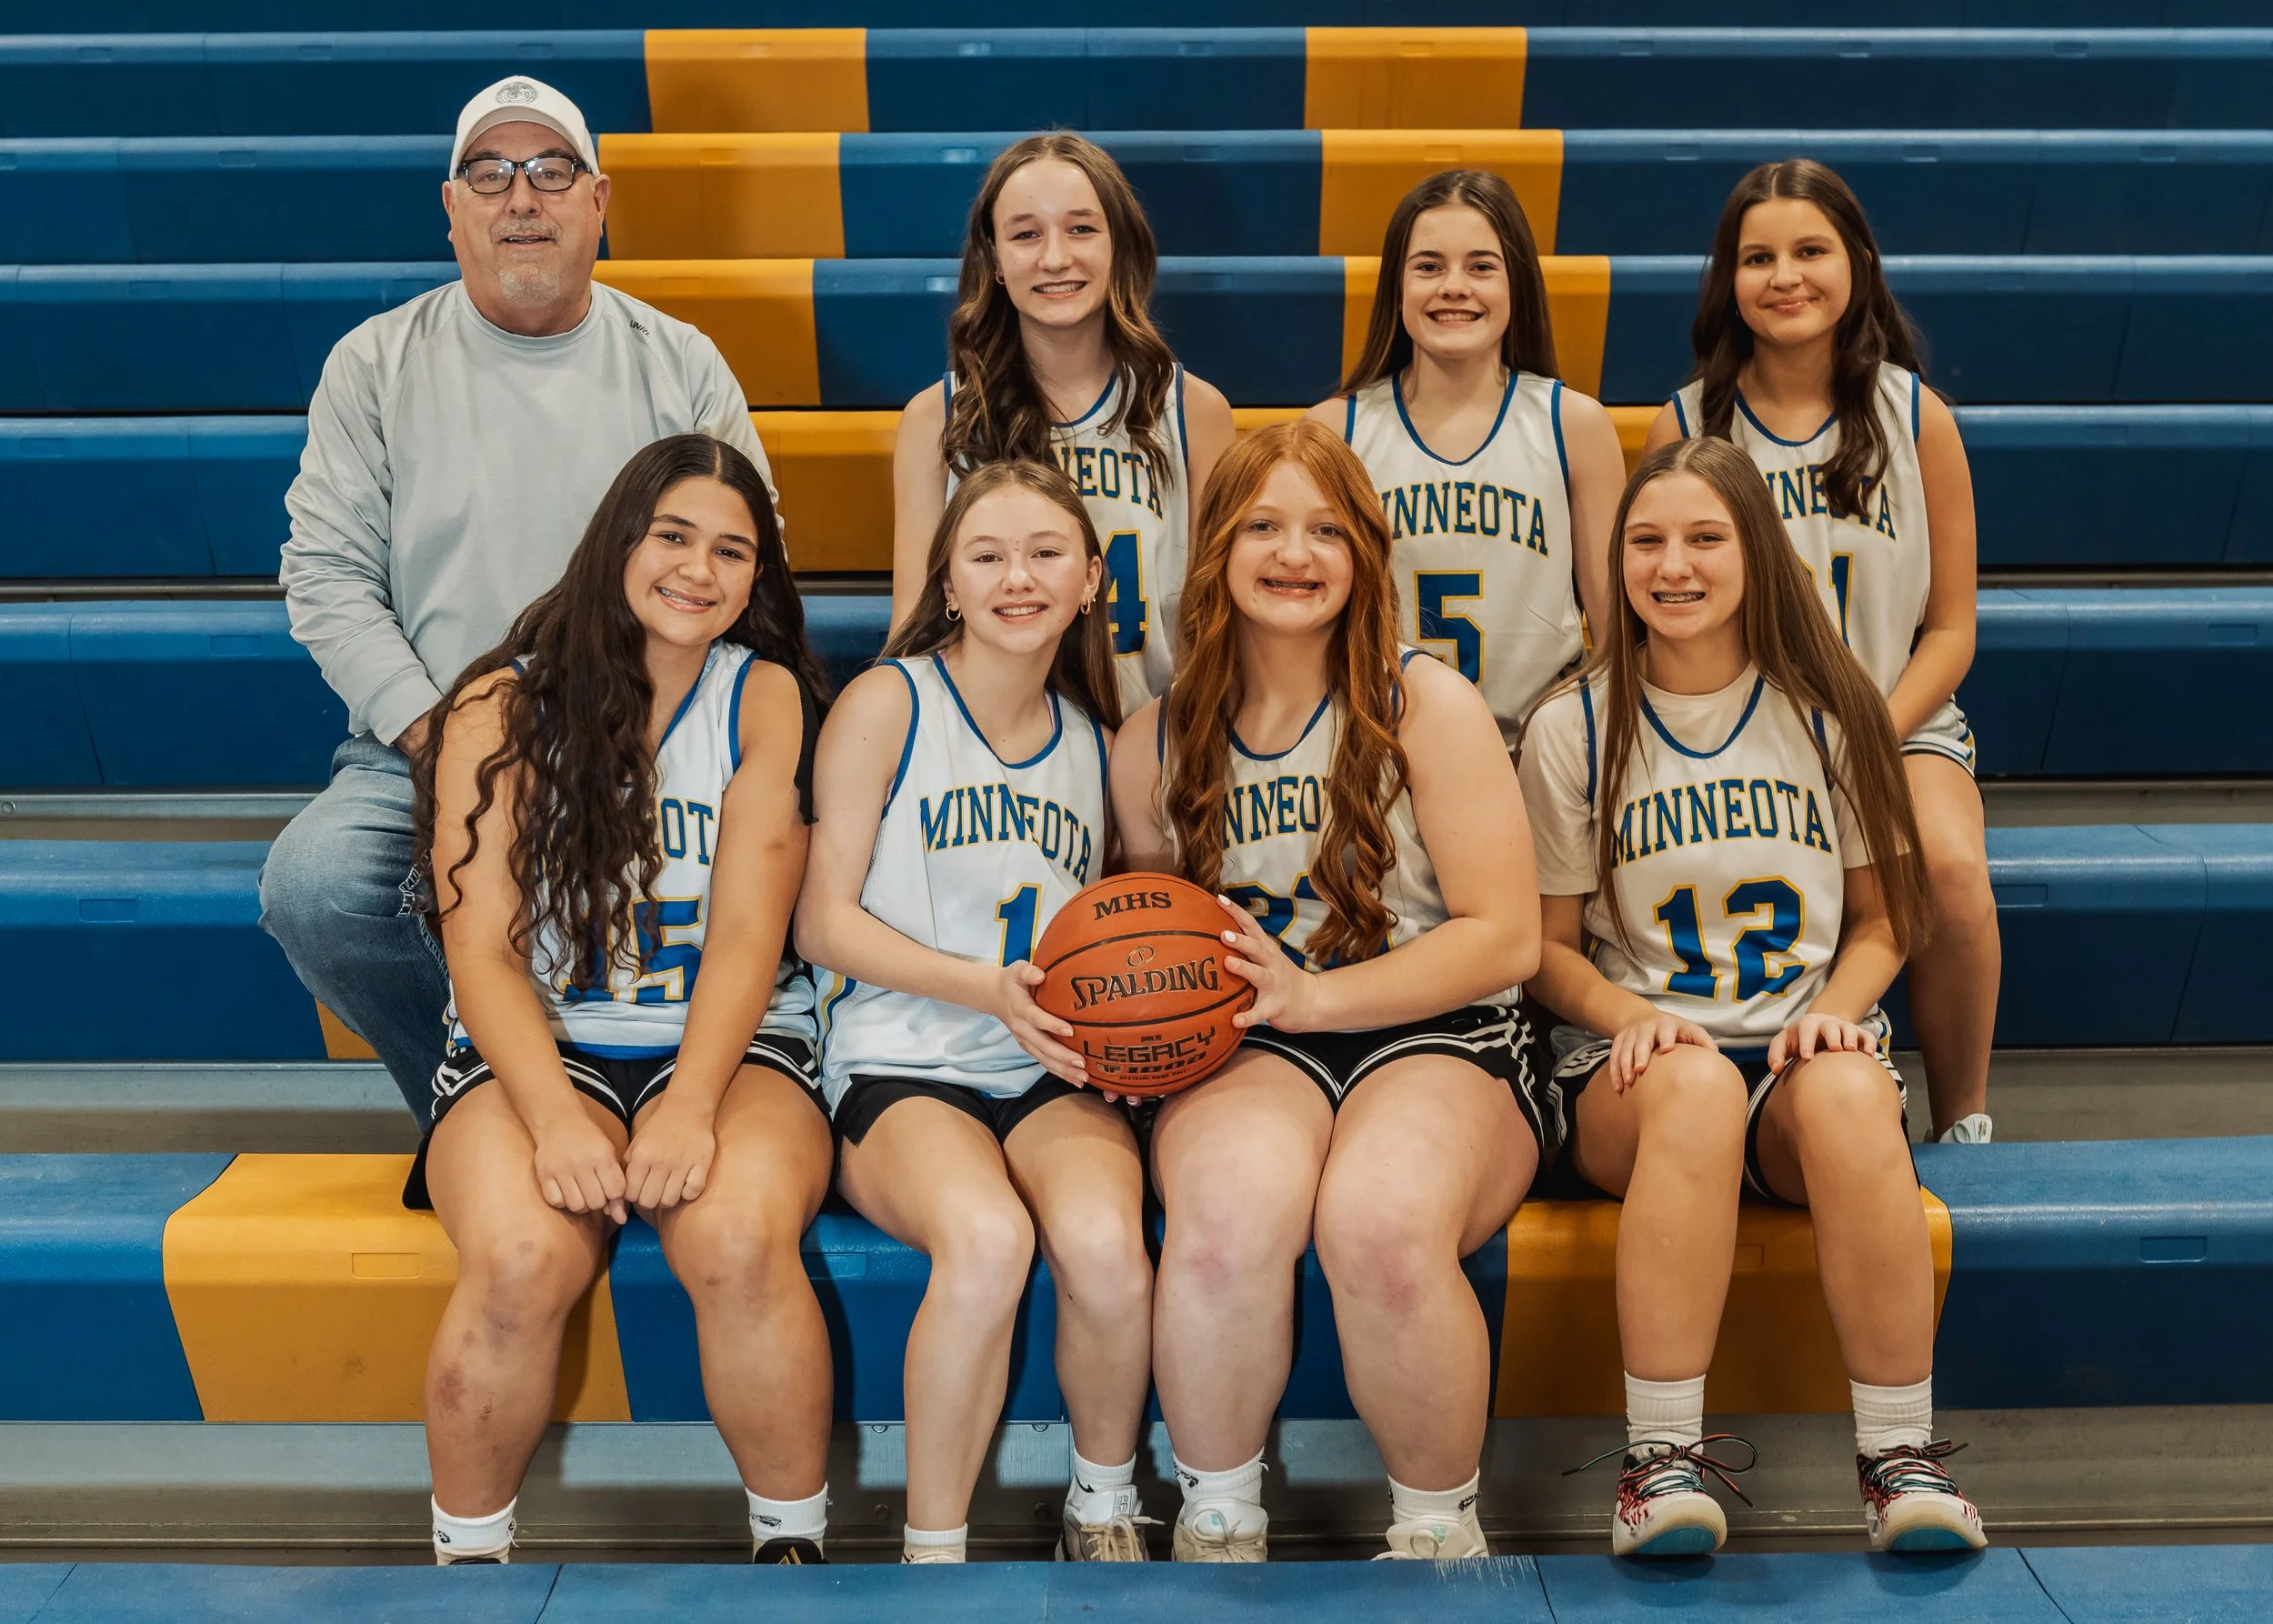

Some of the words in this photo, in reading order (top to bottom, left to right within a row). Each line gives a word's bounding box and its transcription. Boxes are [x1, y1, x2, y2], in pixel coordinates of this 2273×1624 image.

[1413, 569, 1485, 687] 5
[919, 781, 1092, 888] MINNEOTA
[1611, 777, 1835, 869] MINNEOTA
[994, 882, 1043, 968] 1
[1092, 891, 1173, 921] MHS
[1652, 875, 1810, 1004] 12
[1070, 956, 1219, 1012] SPALDING
[1083, 1025, 1217, 1063] LEGACY
